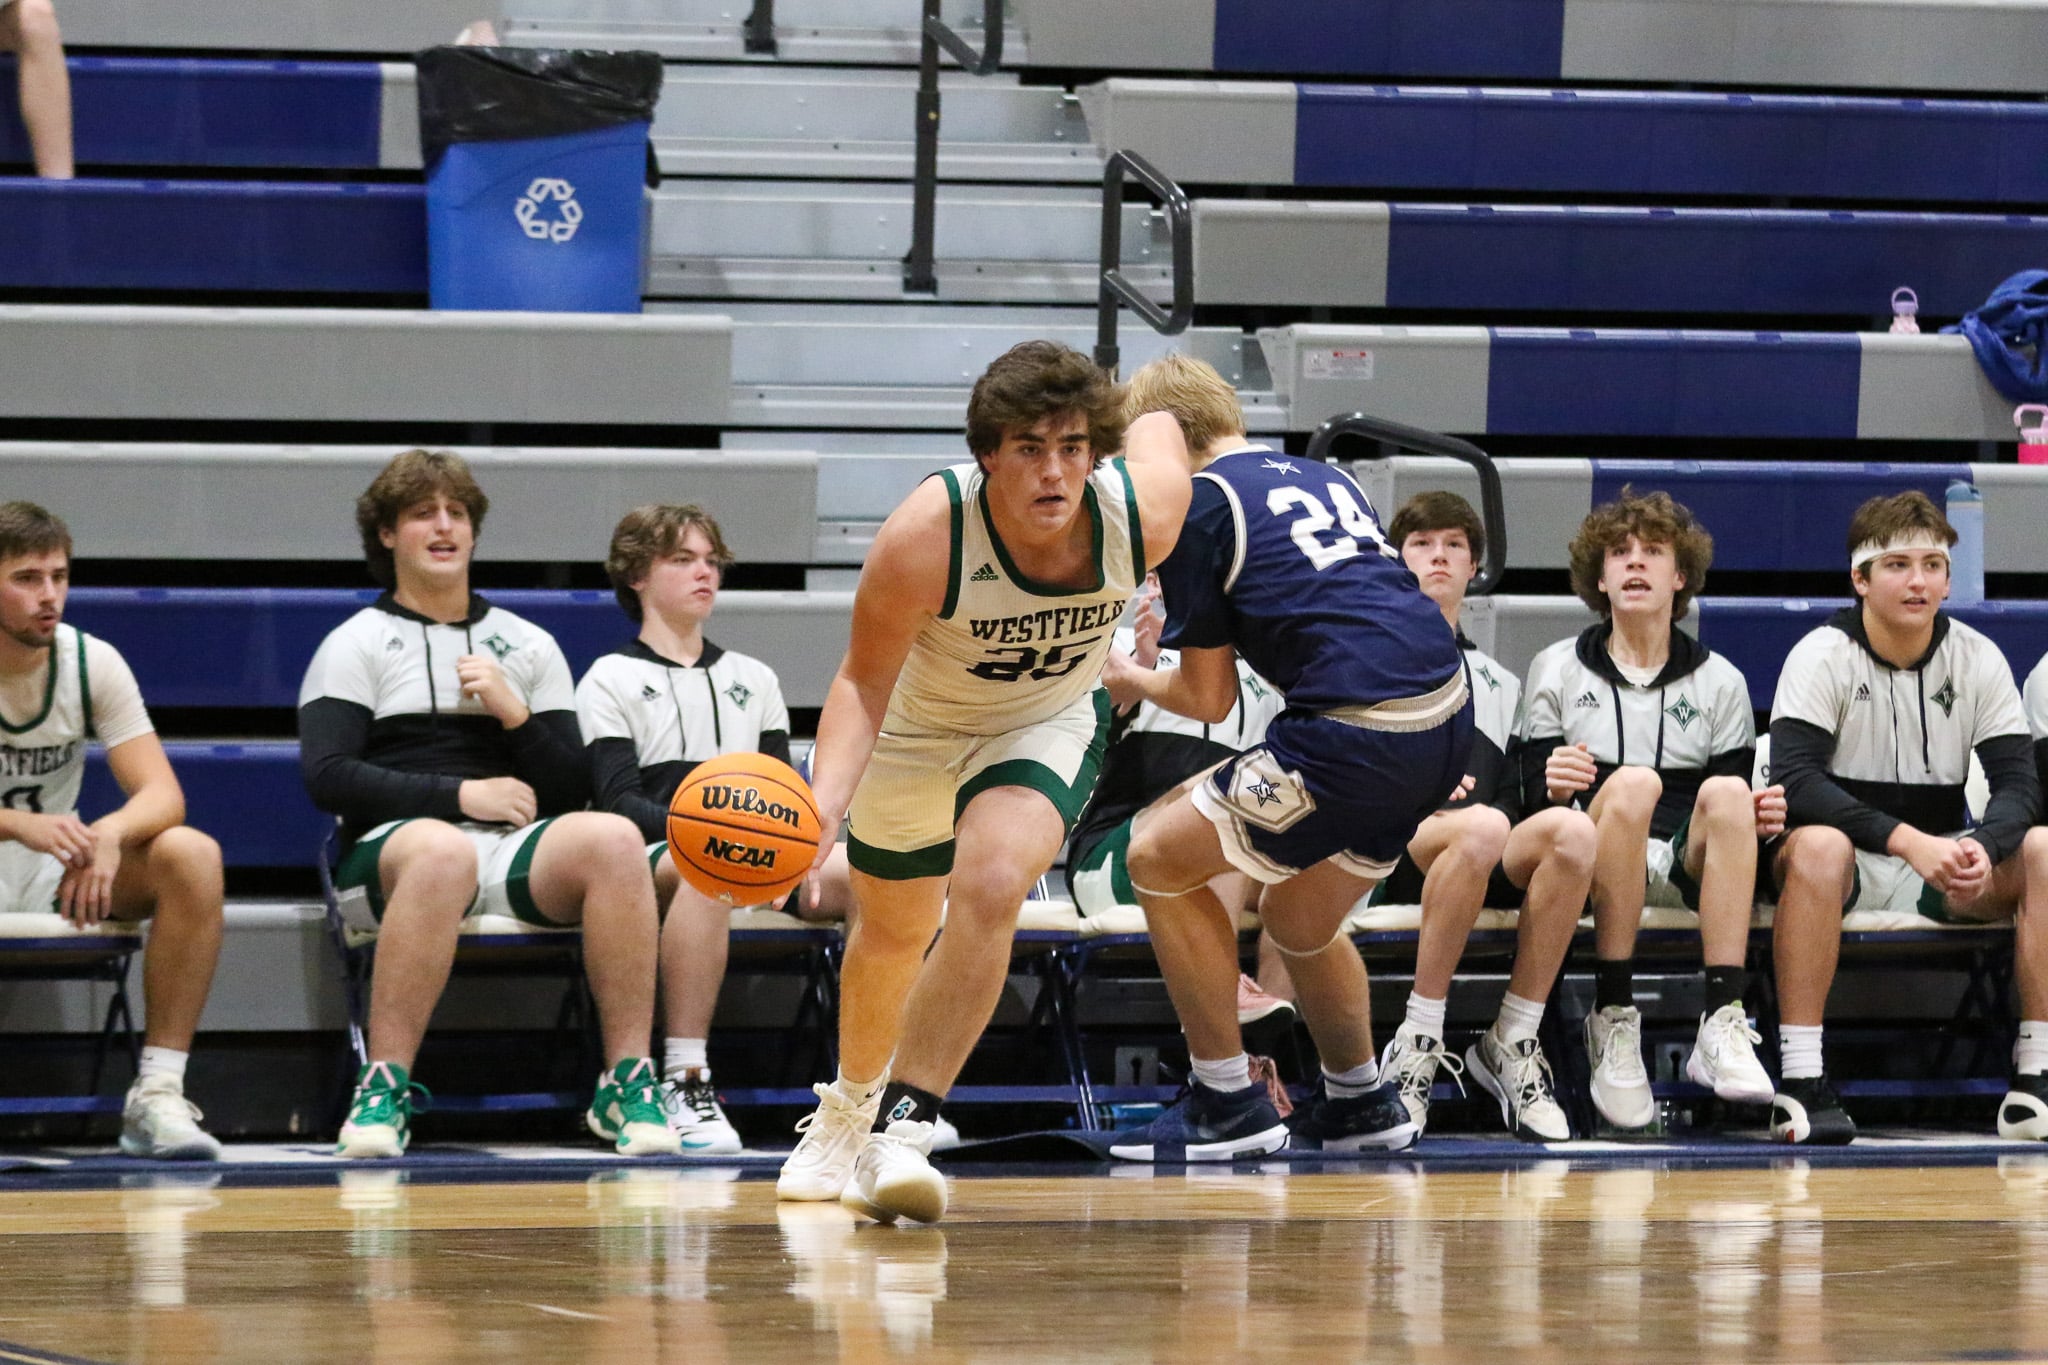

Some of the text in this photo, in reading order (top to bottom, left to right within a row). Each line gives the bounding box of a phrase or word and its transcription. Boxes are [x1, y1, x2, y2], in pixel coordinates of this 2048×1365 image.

[1266, 483, 1399, 571] 24
[970, 573, 998, 582] adidas
[702, 785, 800, 828] Wilson
[703, 836, 777, 869] NCAA
